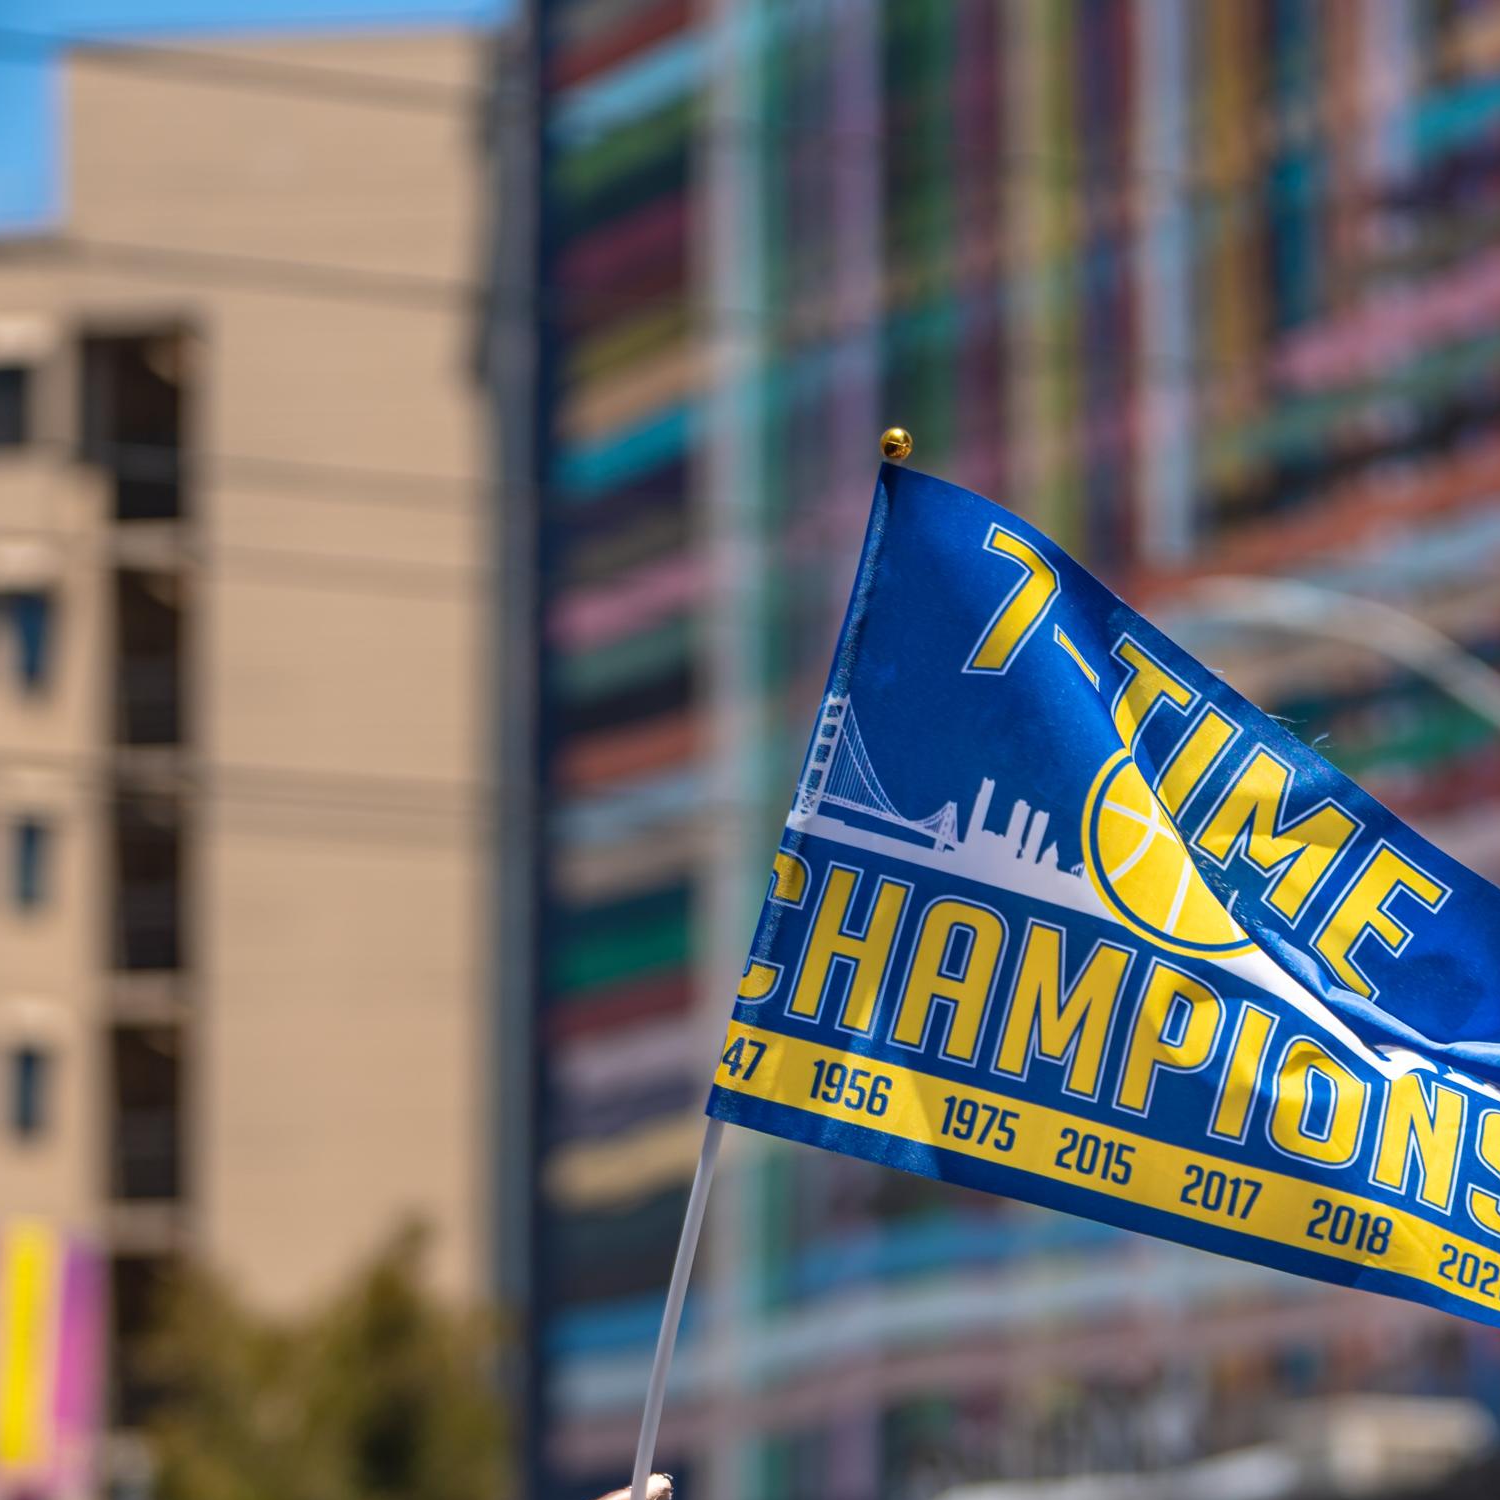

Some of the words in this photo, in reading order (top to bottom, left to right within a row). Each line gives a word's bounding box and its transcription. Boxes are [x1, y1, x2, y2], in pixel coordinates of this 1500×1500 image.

[962, 523, 1452, 1001] 7-TIME
[810, 1058, 891, 1117] 1956
[941, 1094, 1017, 1153] 1975
[1054, 1127, 1137, 1186] 2015
[1180, 1164, 1264, 1220] 2017
[1306, 1198, 1394, 1257] 2018
